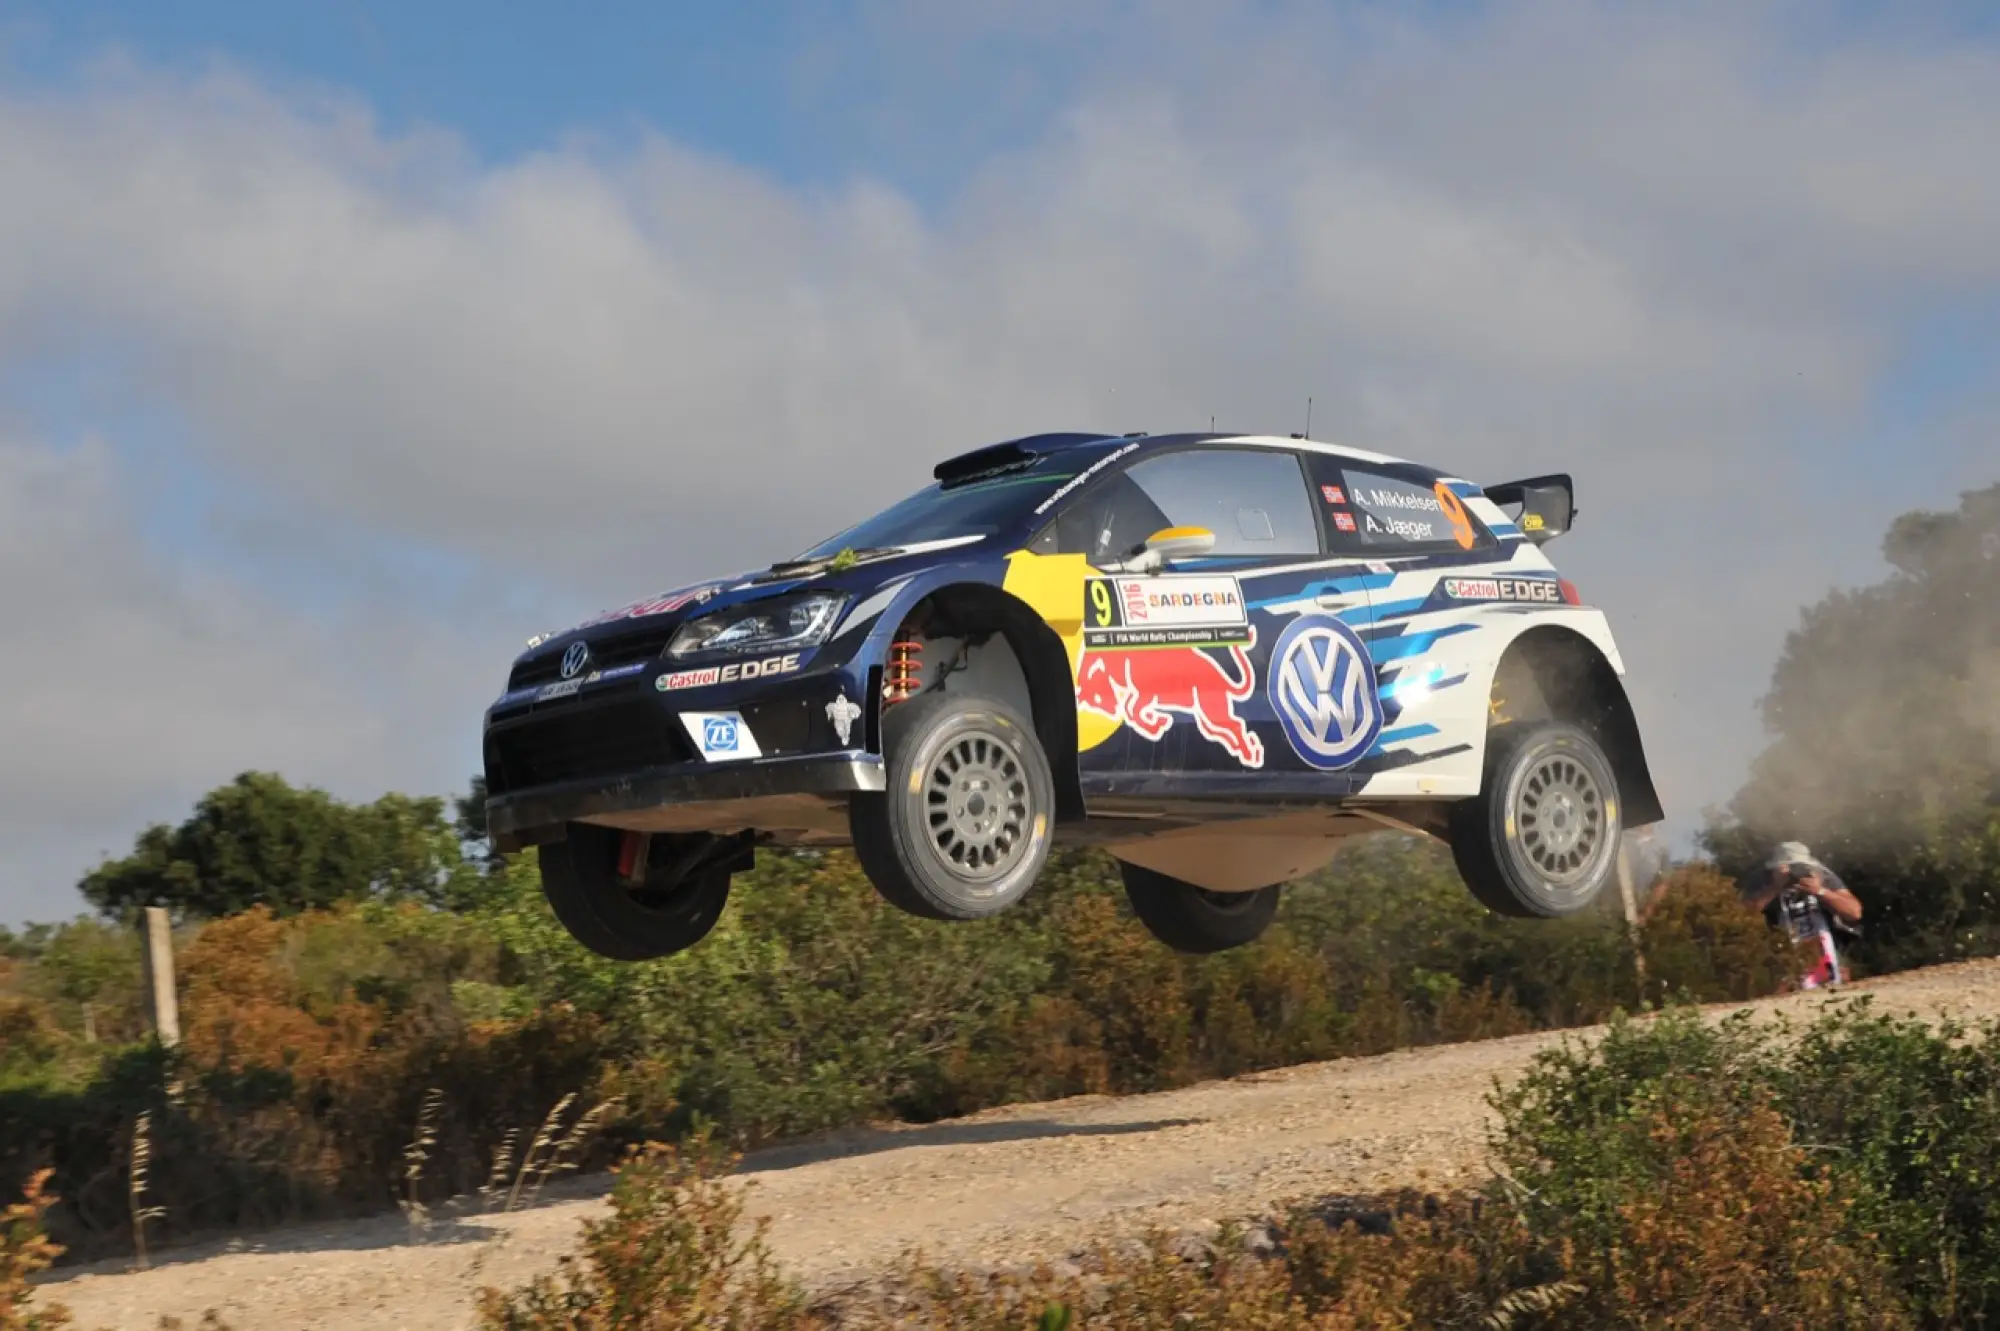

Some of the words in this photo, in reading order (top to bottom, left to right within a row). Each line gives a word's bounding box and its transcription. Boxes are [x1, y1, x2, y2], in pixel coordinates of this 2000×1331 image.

[1354, 488, 1370, 506] A.
[1370, 489, 1443, 514] Mikkelsen
[1366, 515, 1383, 533] A.
[1386, 516, 1433, 540] Jæger
[1434, 481, 1474, 550] 9
[1123, 583, 1148, 621] 2016
[1149, 592, 1238, 607] SARDEGNA
[1459, 582, 1497, 597] Castrol
[1499, 580, 1559, 600] EDGE
[1090, 580, 1112, 627] 9
[669, 669, 717, 689] Castrol
[720, 653, 801, 682] EDGE
[707, 725, 735, 744] ZF
